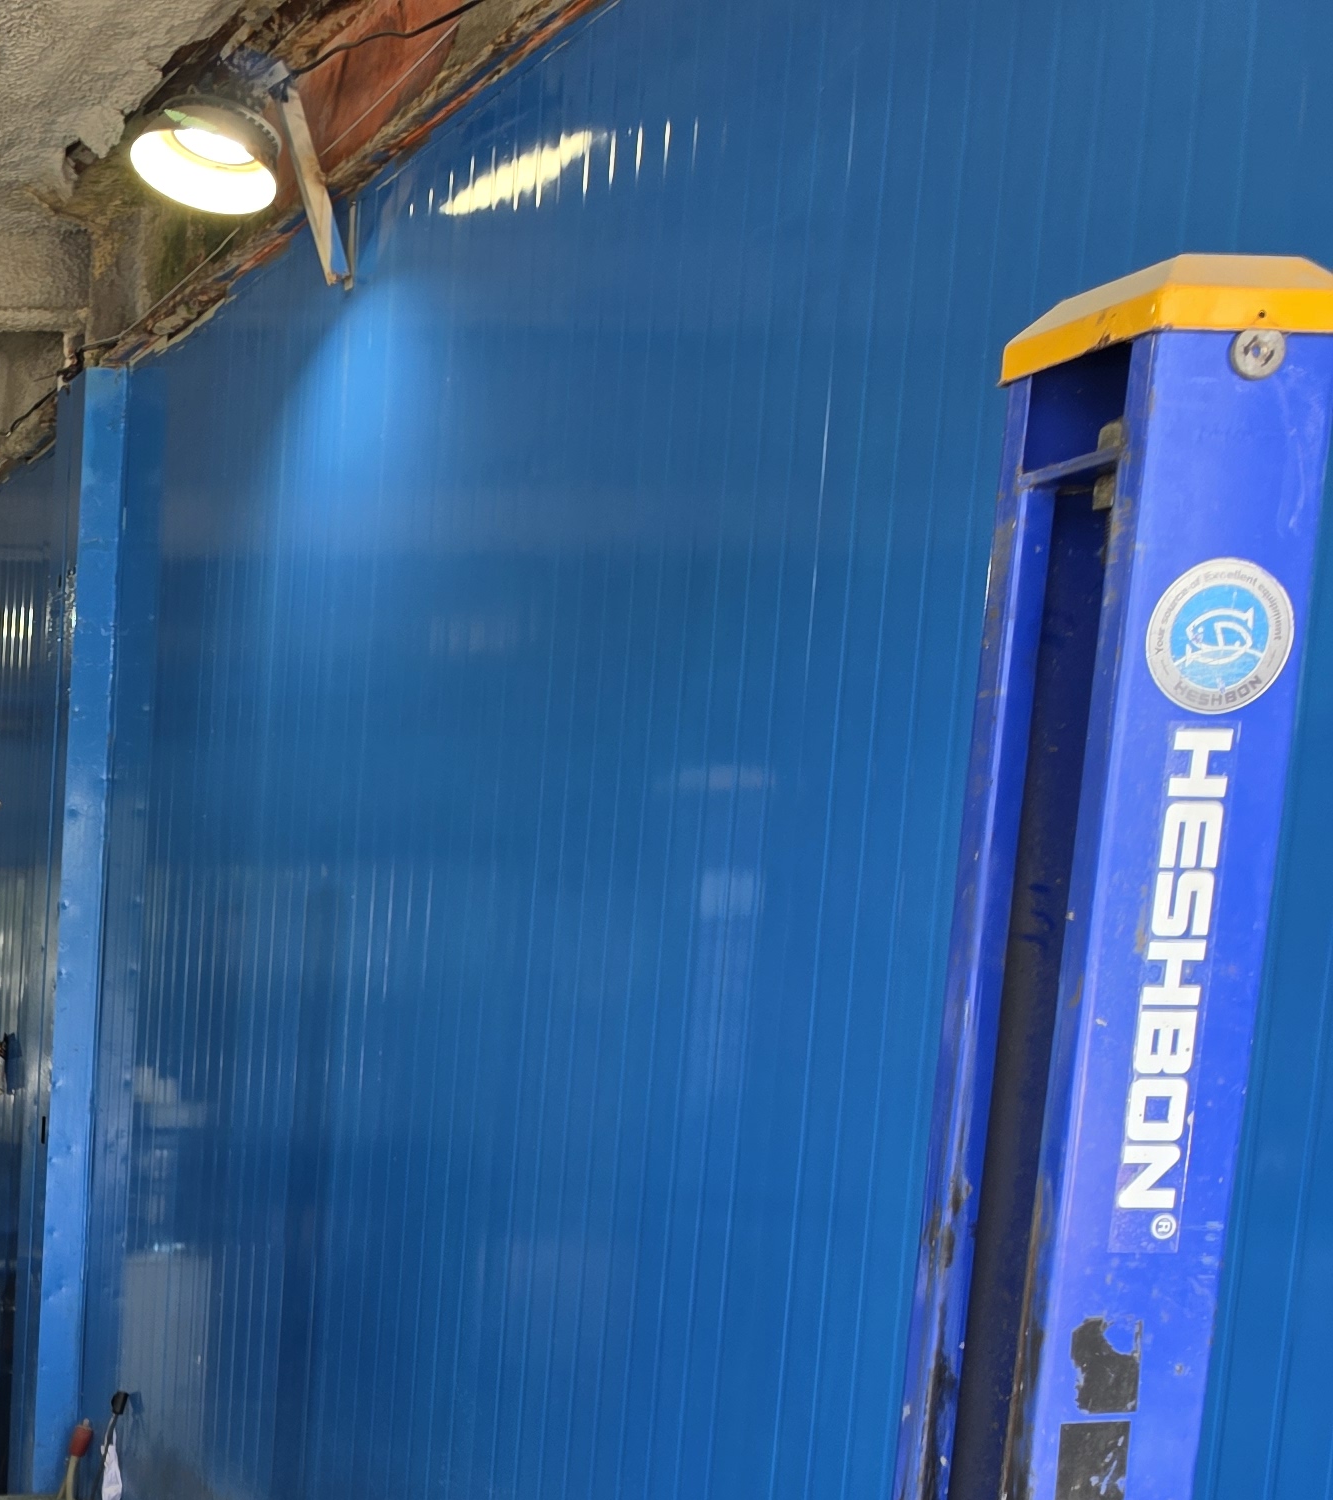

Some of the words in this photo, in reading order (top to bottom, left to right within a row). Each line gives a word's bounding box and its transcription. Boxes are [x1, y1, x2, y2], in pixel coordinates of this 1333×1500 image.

[1204, 570, 1258, 587] Excellent
[1173, 675, 1263, 707] HESHBON
[1116, 728, 1234, 1210] HESHBON
